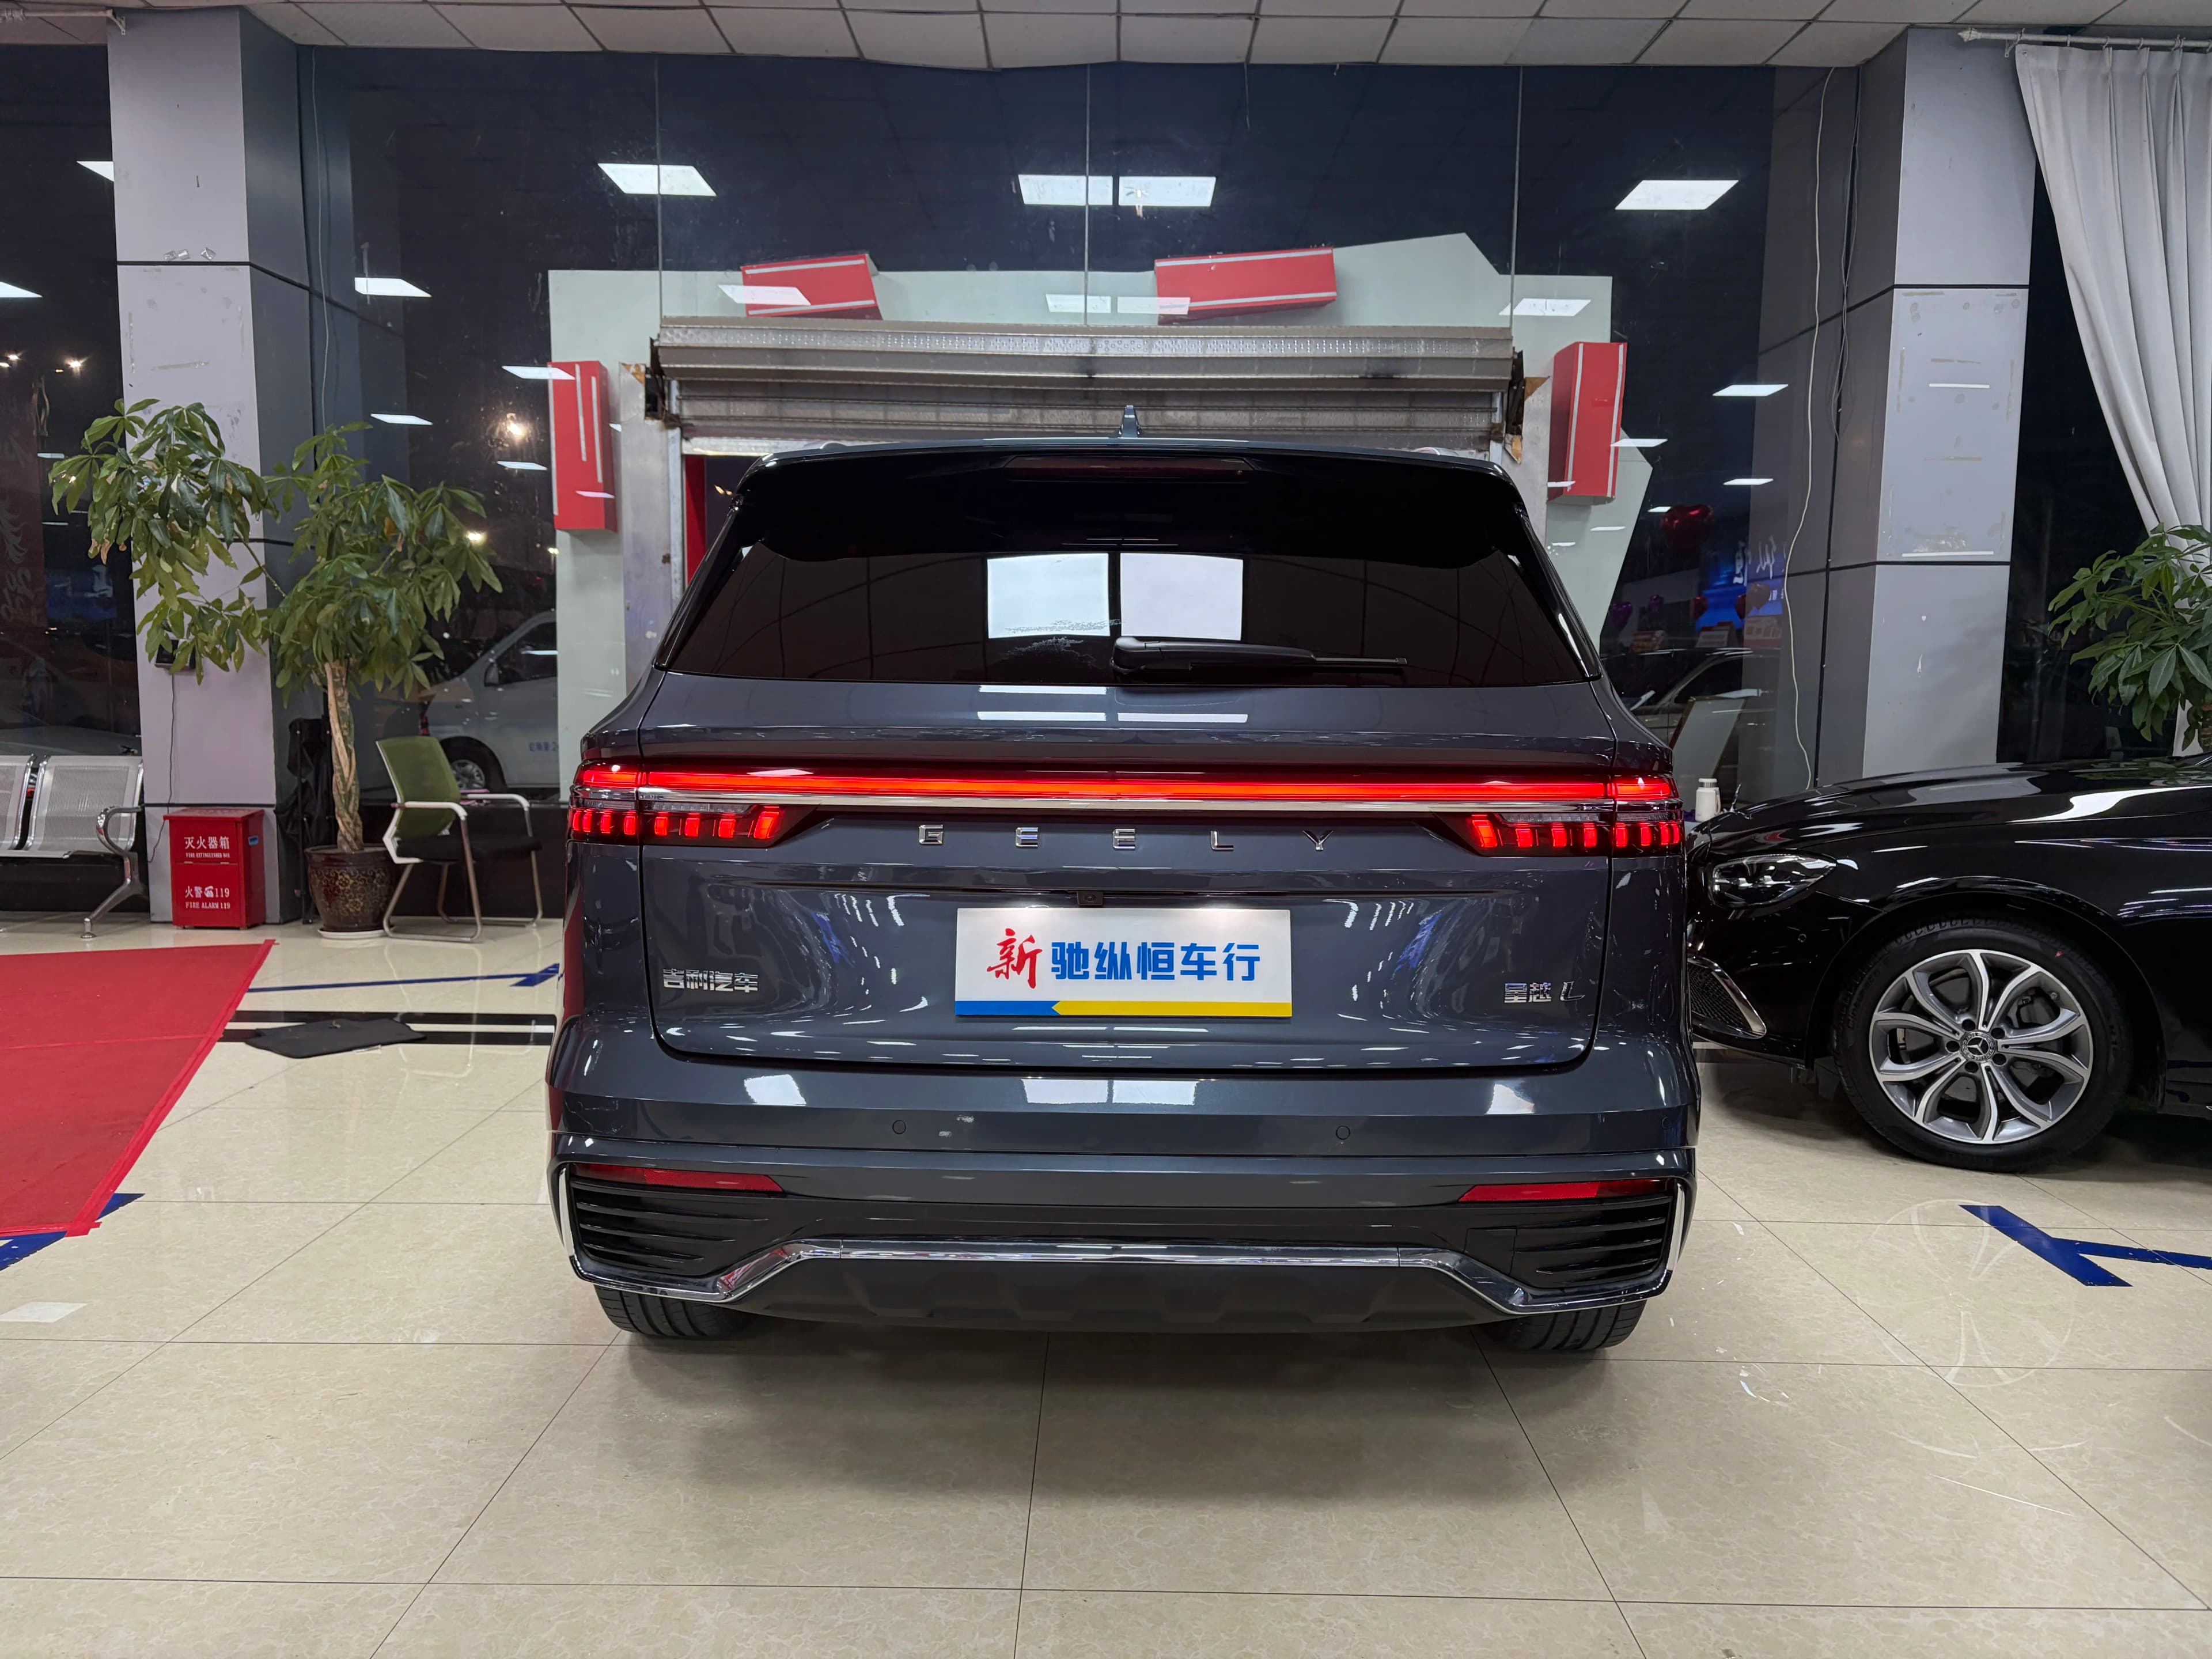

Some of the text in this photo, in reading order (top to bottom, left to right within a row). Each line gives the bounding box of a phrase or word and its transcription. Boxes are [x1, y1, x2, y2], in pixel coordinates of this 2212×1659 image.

[184, 836, 230, 850] 灭火器箱
[919, 824, 1333, 851] GEELY
[185, 885, 230, 898] 火警 119
[986, 928, 1260, 989] 新驰纵恒车行
[663, 968, 759, 993] 吉利汽车
[1504, 981, 1585, 1003] 星越 L
